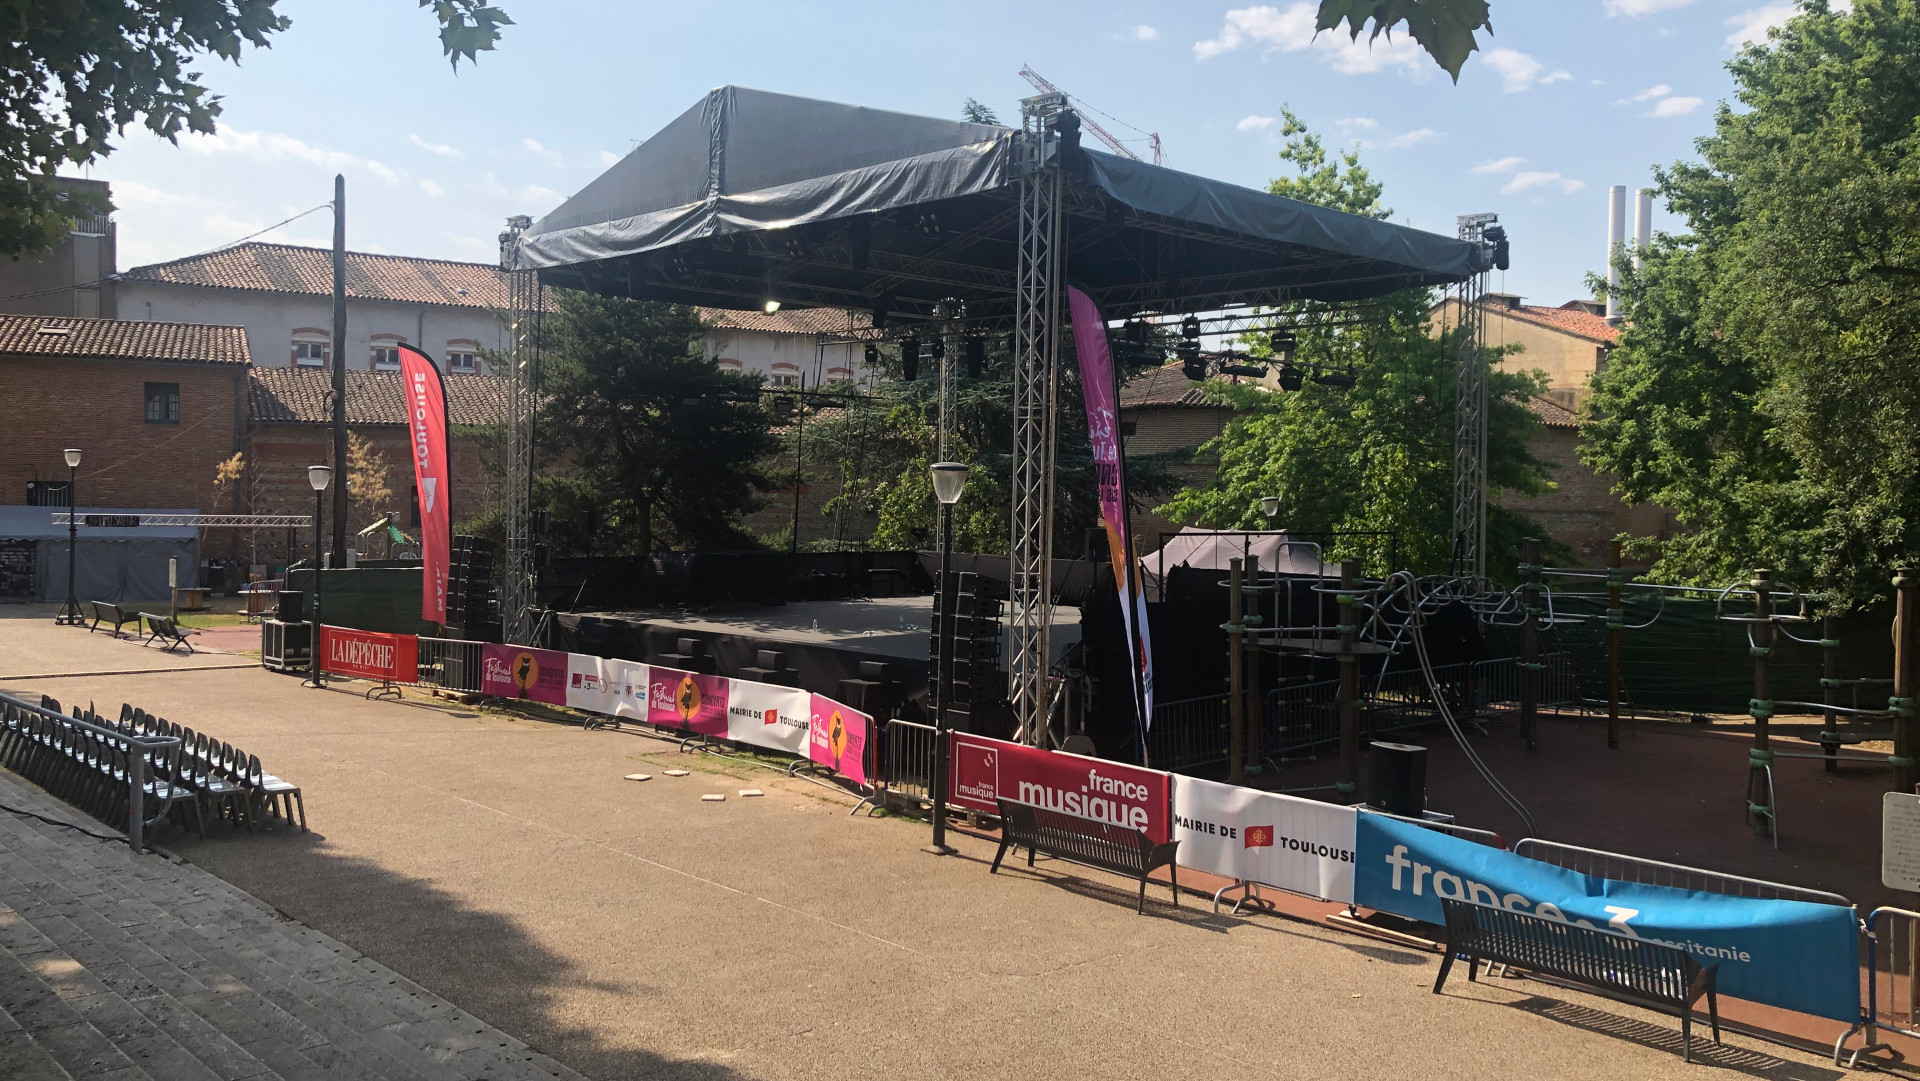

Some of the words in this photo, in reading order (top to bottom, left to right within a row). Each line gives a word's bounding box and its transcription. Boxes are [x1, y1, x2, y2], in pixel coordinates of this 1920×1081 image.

[331, 638, 344, 662] LA
[345, 637, 394, 669] DÉPÊCHE
[484, 657, 512, 676] Festival
[650, 682, 676, 703] Festival
[729, 706, 752, 717] MAIRIE
[753, 710, 762, 719] DE
[780, 716, 809, 730] TOULOUSE
[959, 784, 994, 799] musique
[978, 780, 994, 790] france
[1088, 768, 1149, 802] france
[1018, 779, 1149, 833] musique
[1174, 814, 1216, 835] MAIRIE
[1219, 824, 1237, 840] DE
[1280, 836, 1356, 864] TOULOUSE
